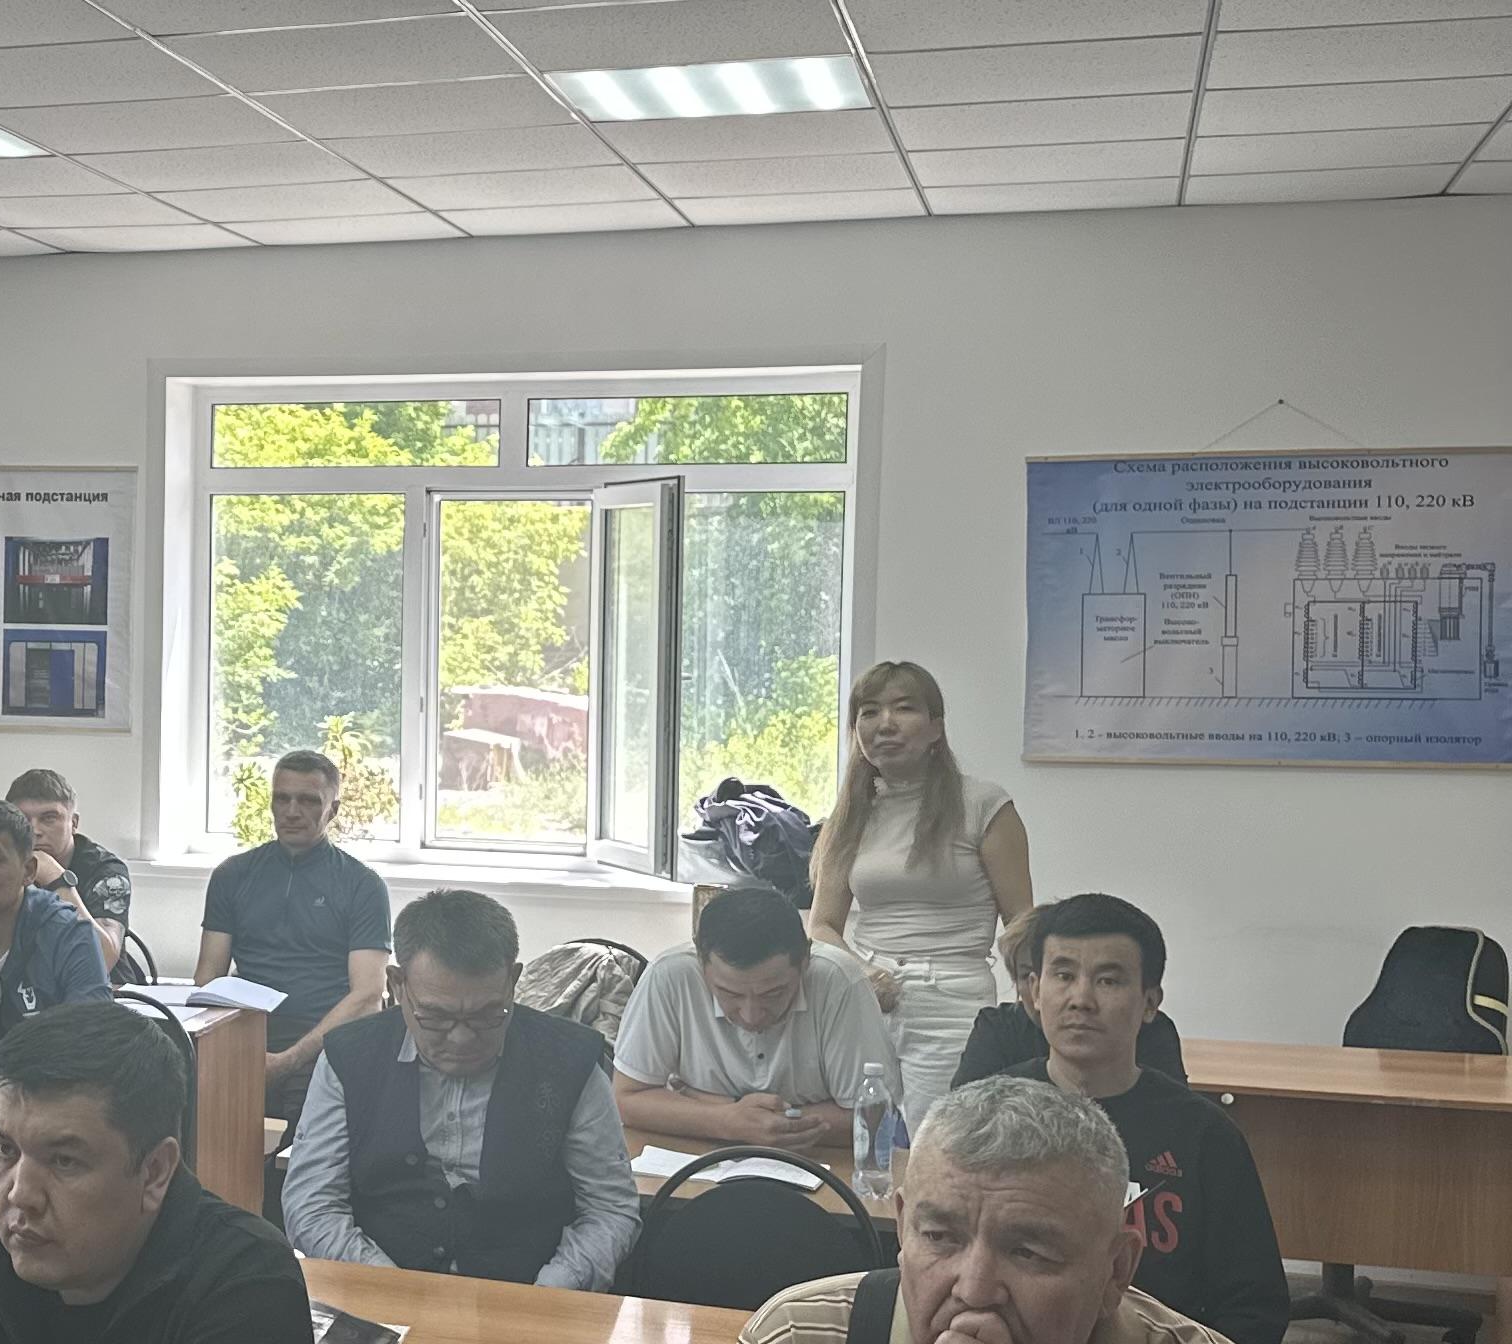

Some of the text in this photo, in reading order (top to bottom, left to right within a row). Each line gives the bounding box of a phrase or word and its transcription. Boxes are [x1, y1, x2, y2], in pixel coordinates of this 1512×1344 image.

[1113, 457, 1449, 476] Схема расположения высоковольтного
[1185, 476, 1373, 494] электрооборудования
[25, 490, 109, 505] подстанция
[1092, 494, 1475, 515] (для одной фазы) на подстанции 110, 220 кВ
[1087, 729, 1096, 739] 2
[1106, 731, 1205, 741] высоковольтные
[1208, 732, 1245, 742] вводы
[1248, 733, 1263, 742] на
[1267, 731, 1291, 743] 110,
[1294, 731, 1317, 743] 220
[1344, 731, 1351, 742] 3
[1365, 732, 1422, 745] опорный
[1425, 735, 1482, 746] изолятор
